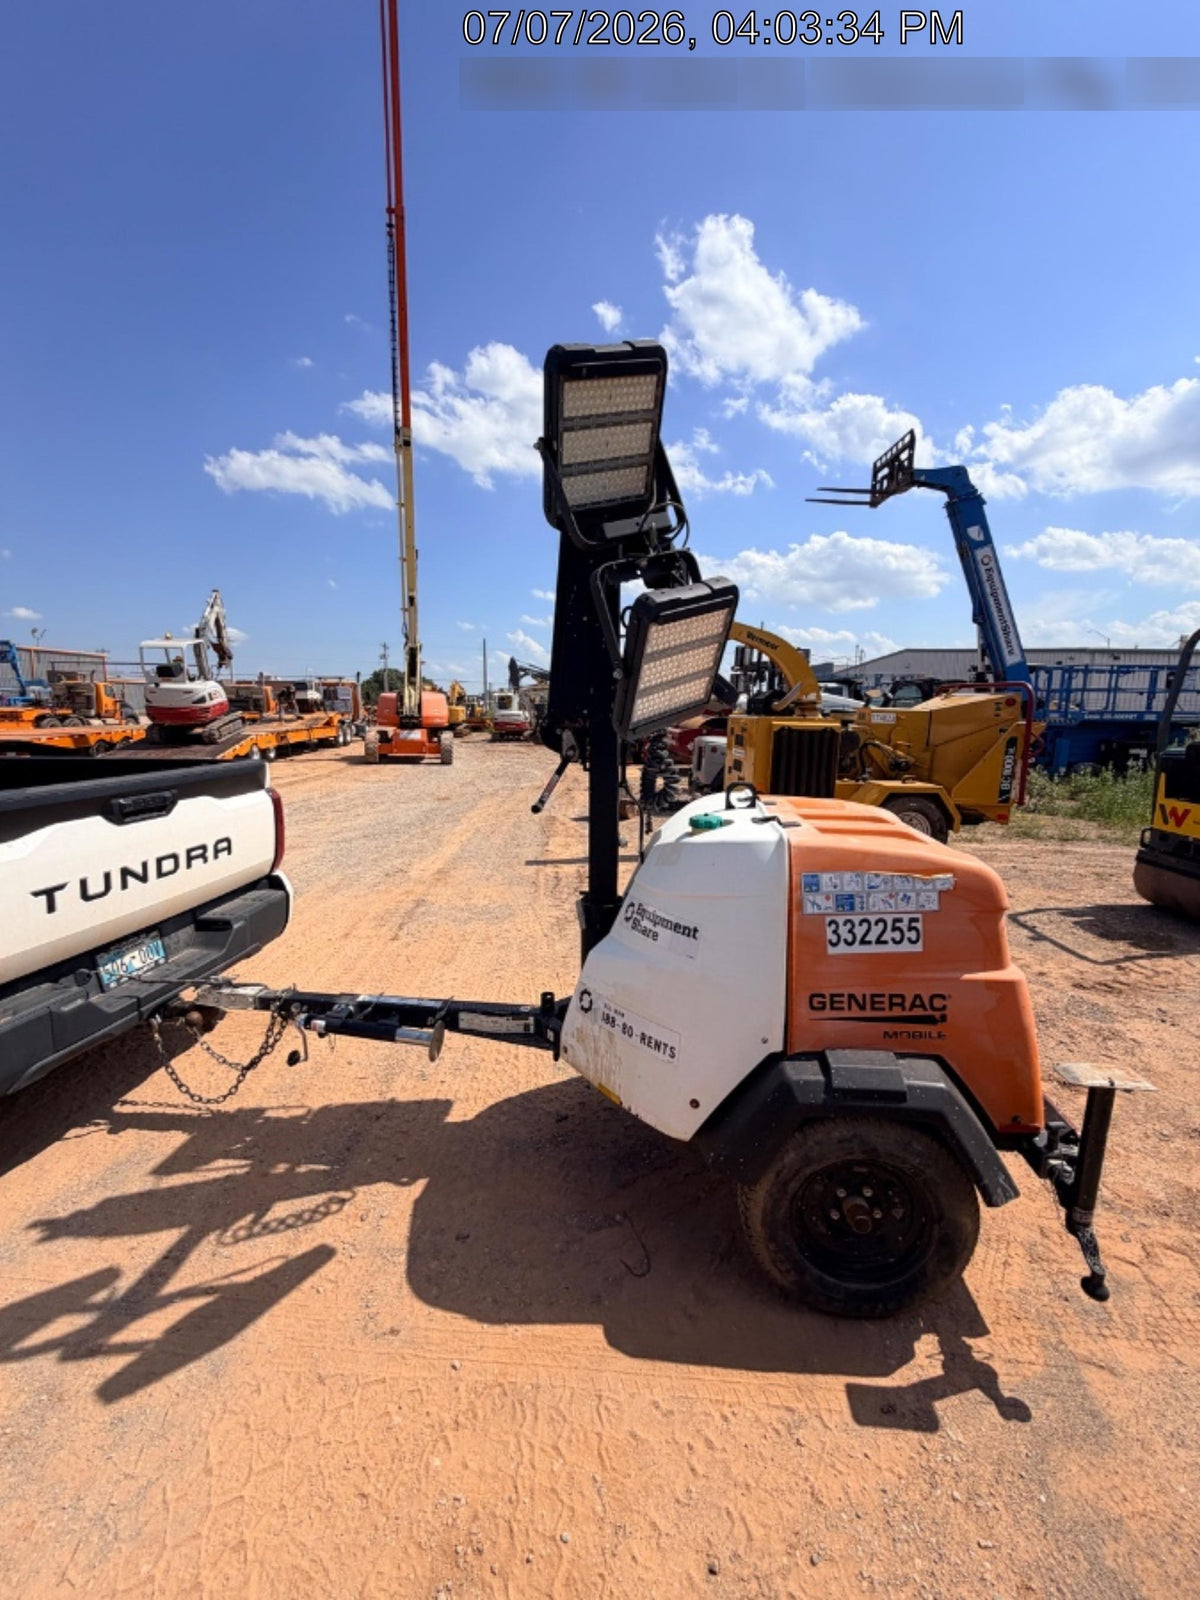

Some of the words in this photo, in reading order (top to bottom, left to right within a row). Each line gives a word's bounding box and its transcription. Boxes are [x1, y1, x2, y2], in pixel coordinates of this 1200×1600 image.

[29, 836, 232, 914] TUNDRA
[631, 917, 659, 941] Share
[636, 902, 699, 940] Equipment
[827, 917, 921, 947] 332255
[808, 993, 947, 1012] GENERAC
[882, 1030, 946, 1040] MOBILE
